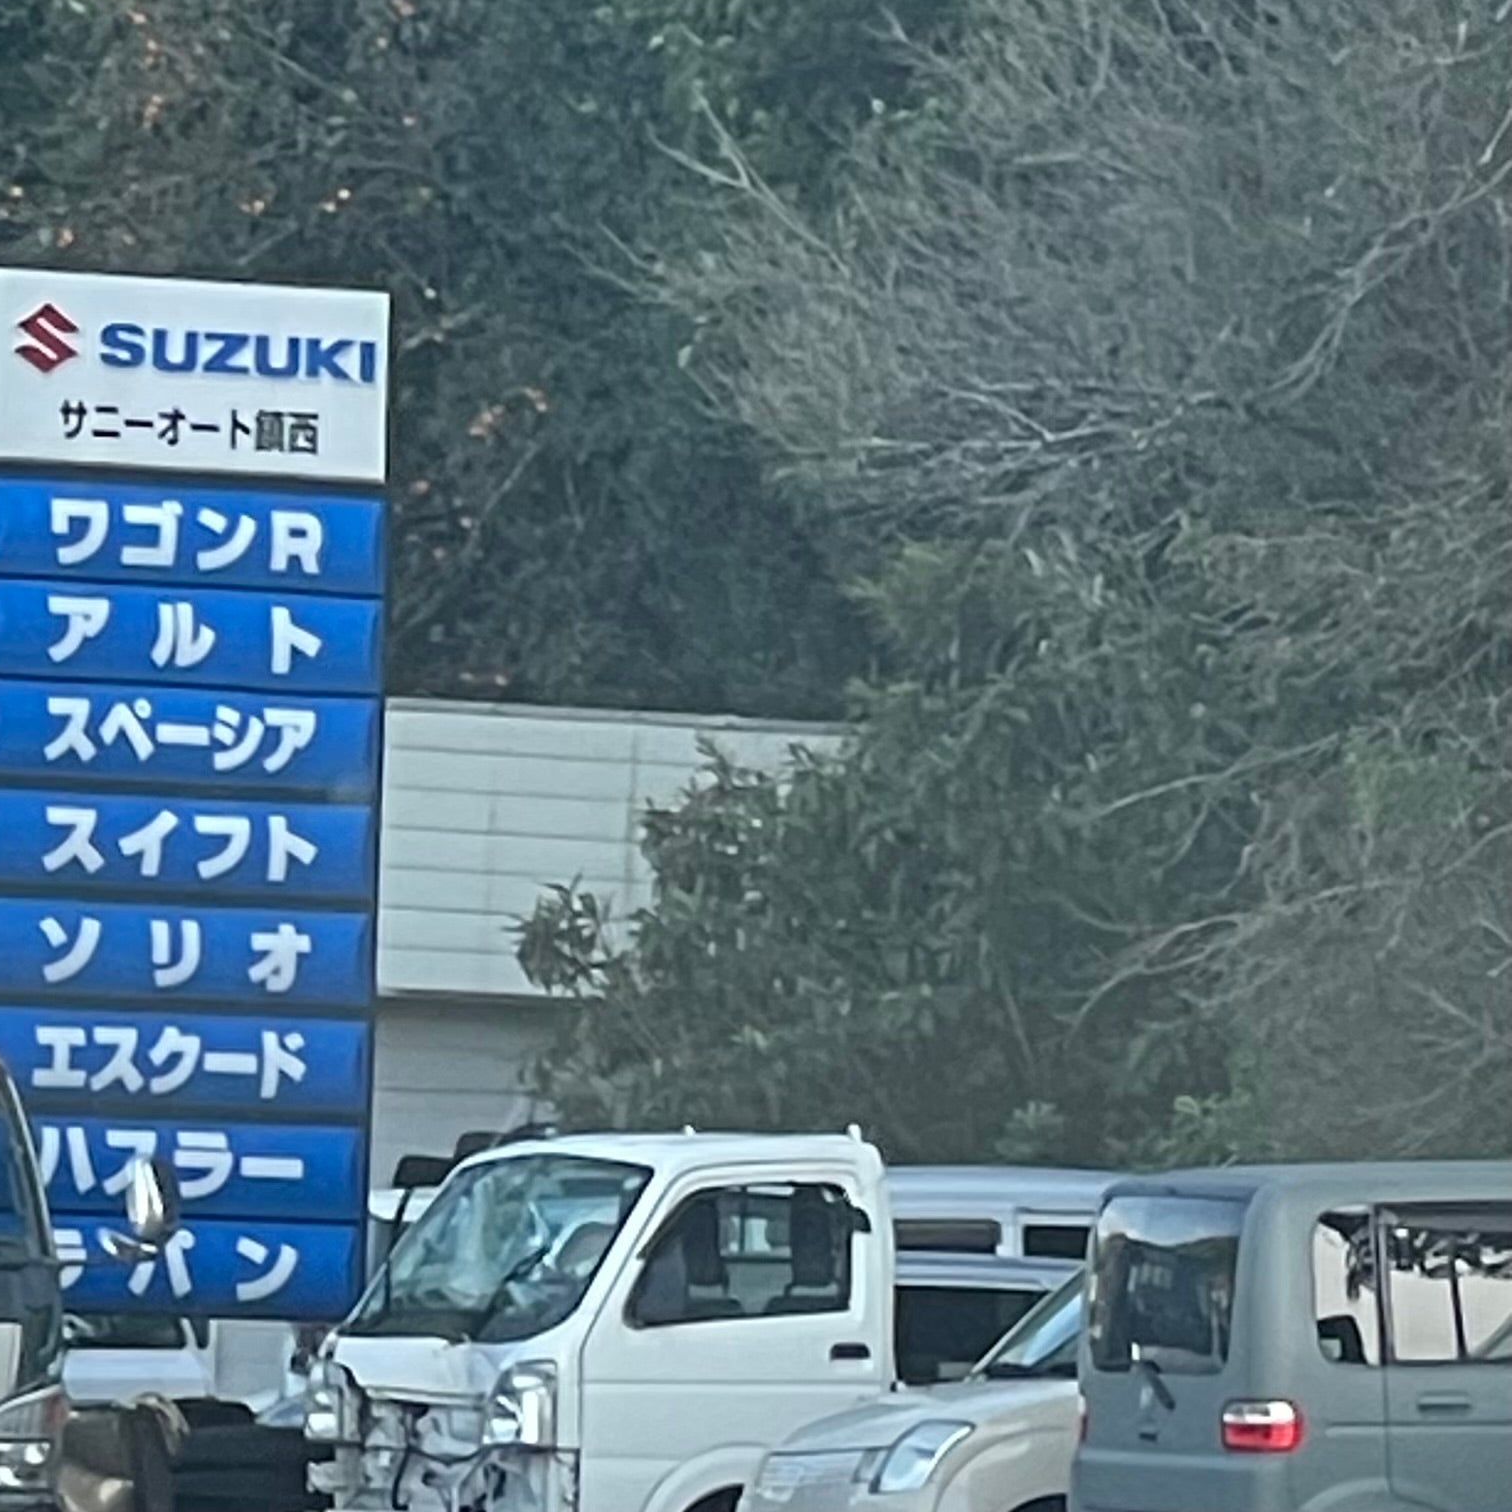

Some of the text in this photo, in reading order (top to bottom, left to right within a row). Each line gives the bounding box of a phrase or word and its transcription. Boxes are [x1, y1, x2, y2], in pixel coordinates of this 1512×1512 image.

[99, 323, 376, 383] SUZUKI
[50, 498, 323, 574] ワゴンR
[47, 596, 322, 674] アルト
[43, 697, 317, 773] スペーシア
[41, 806, 319, 882] スイフト
[38, 915, 312, 992] ソリオ
[31, 1024, 307, 1099] エスクード
[40, 1126, 305, 1199] ハスラー
